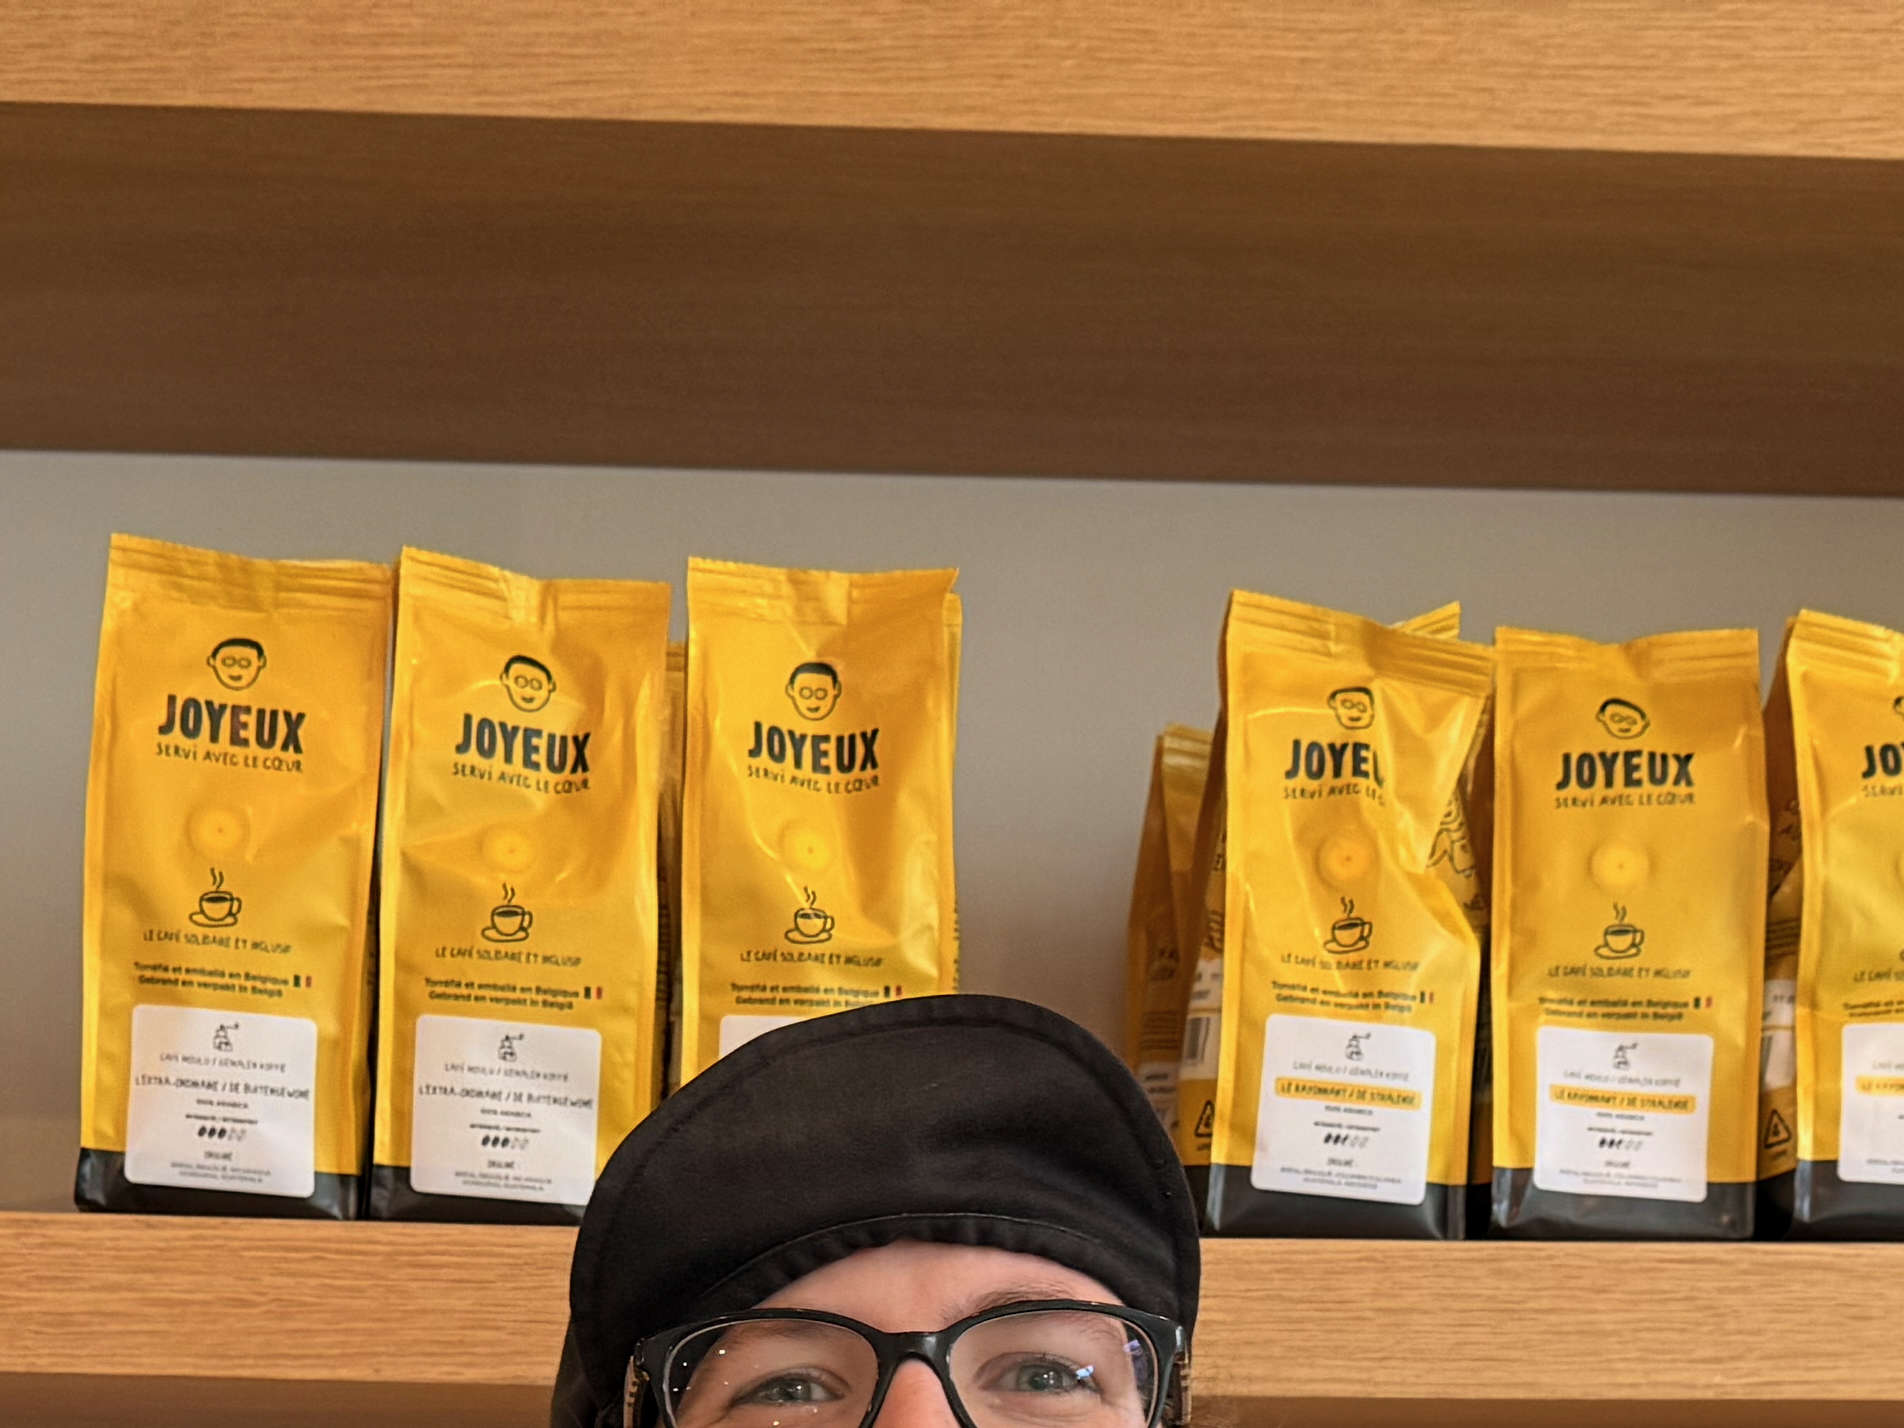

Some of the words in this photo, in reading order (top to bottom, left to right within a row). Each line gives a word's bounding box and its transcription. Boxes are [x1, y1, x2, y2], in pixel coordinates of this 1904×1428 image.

[157, 694, 306, 757] JOYEUX
[748, 721, 879, 778] JOYEUX
[1556, 749, 1694, 790] JOYEUX
